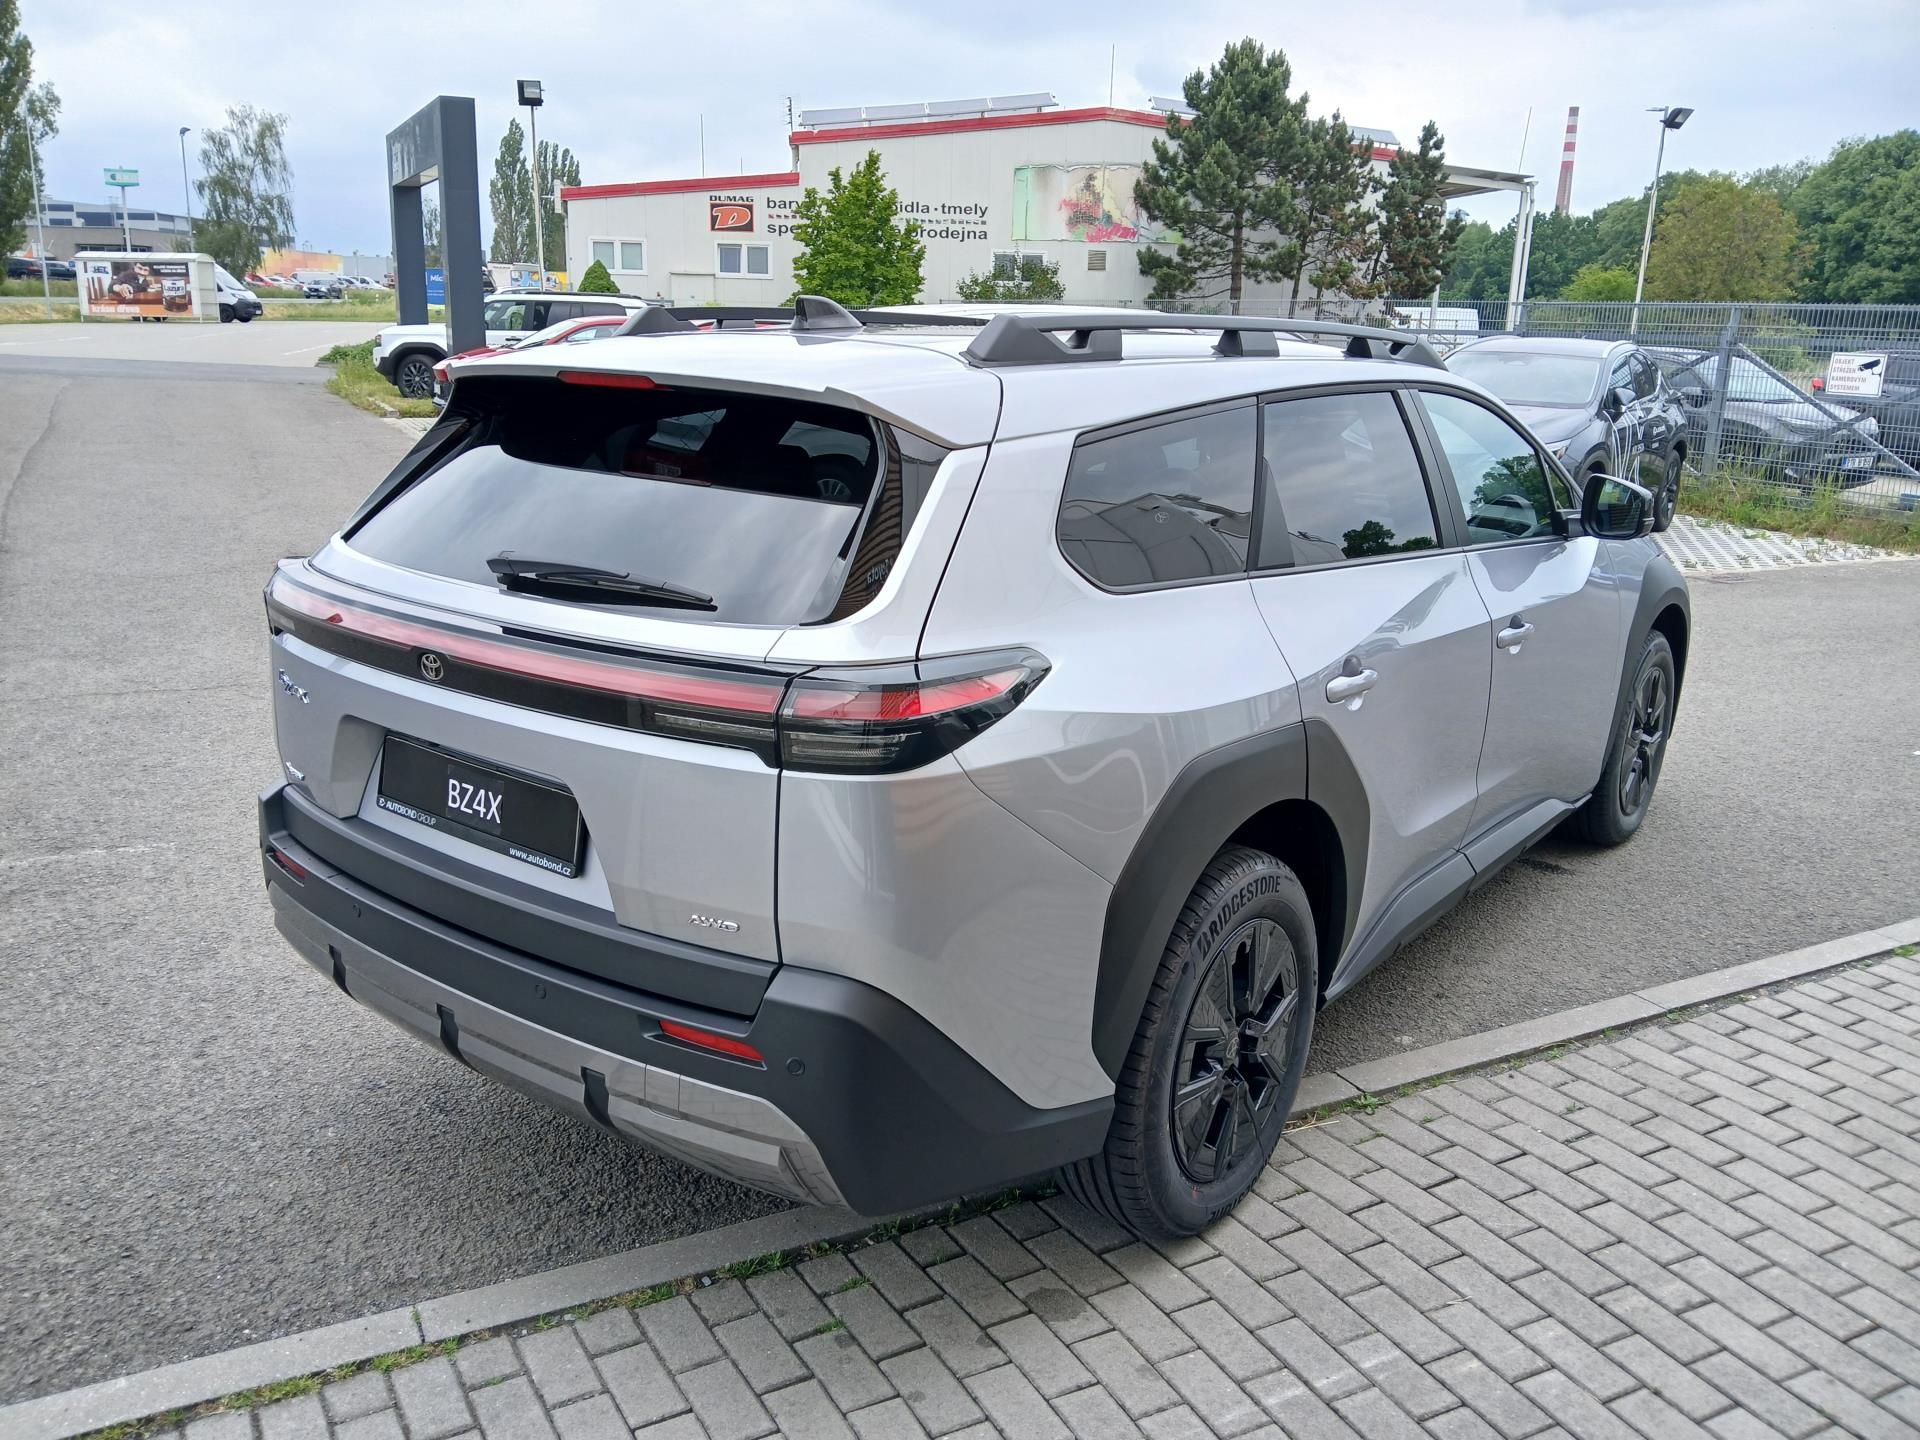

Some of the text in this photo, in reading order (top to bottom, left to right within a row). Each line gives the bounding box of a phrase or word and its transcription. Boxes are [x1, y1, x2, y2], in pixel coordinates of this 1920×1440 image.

[941, 203, 988, 218] tmely
[385, 800, 417, 819] AUTOBOND
[447, 778, 503, 824] BZ4X
[509, 847, 572, 876] www.autobond.cz
[688, 914, 741, 933] AWD
[1198, 876, 1281, 959] BRIDGESTONE
